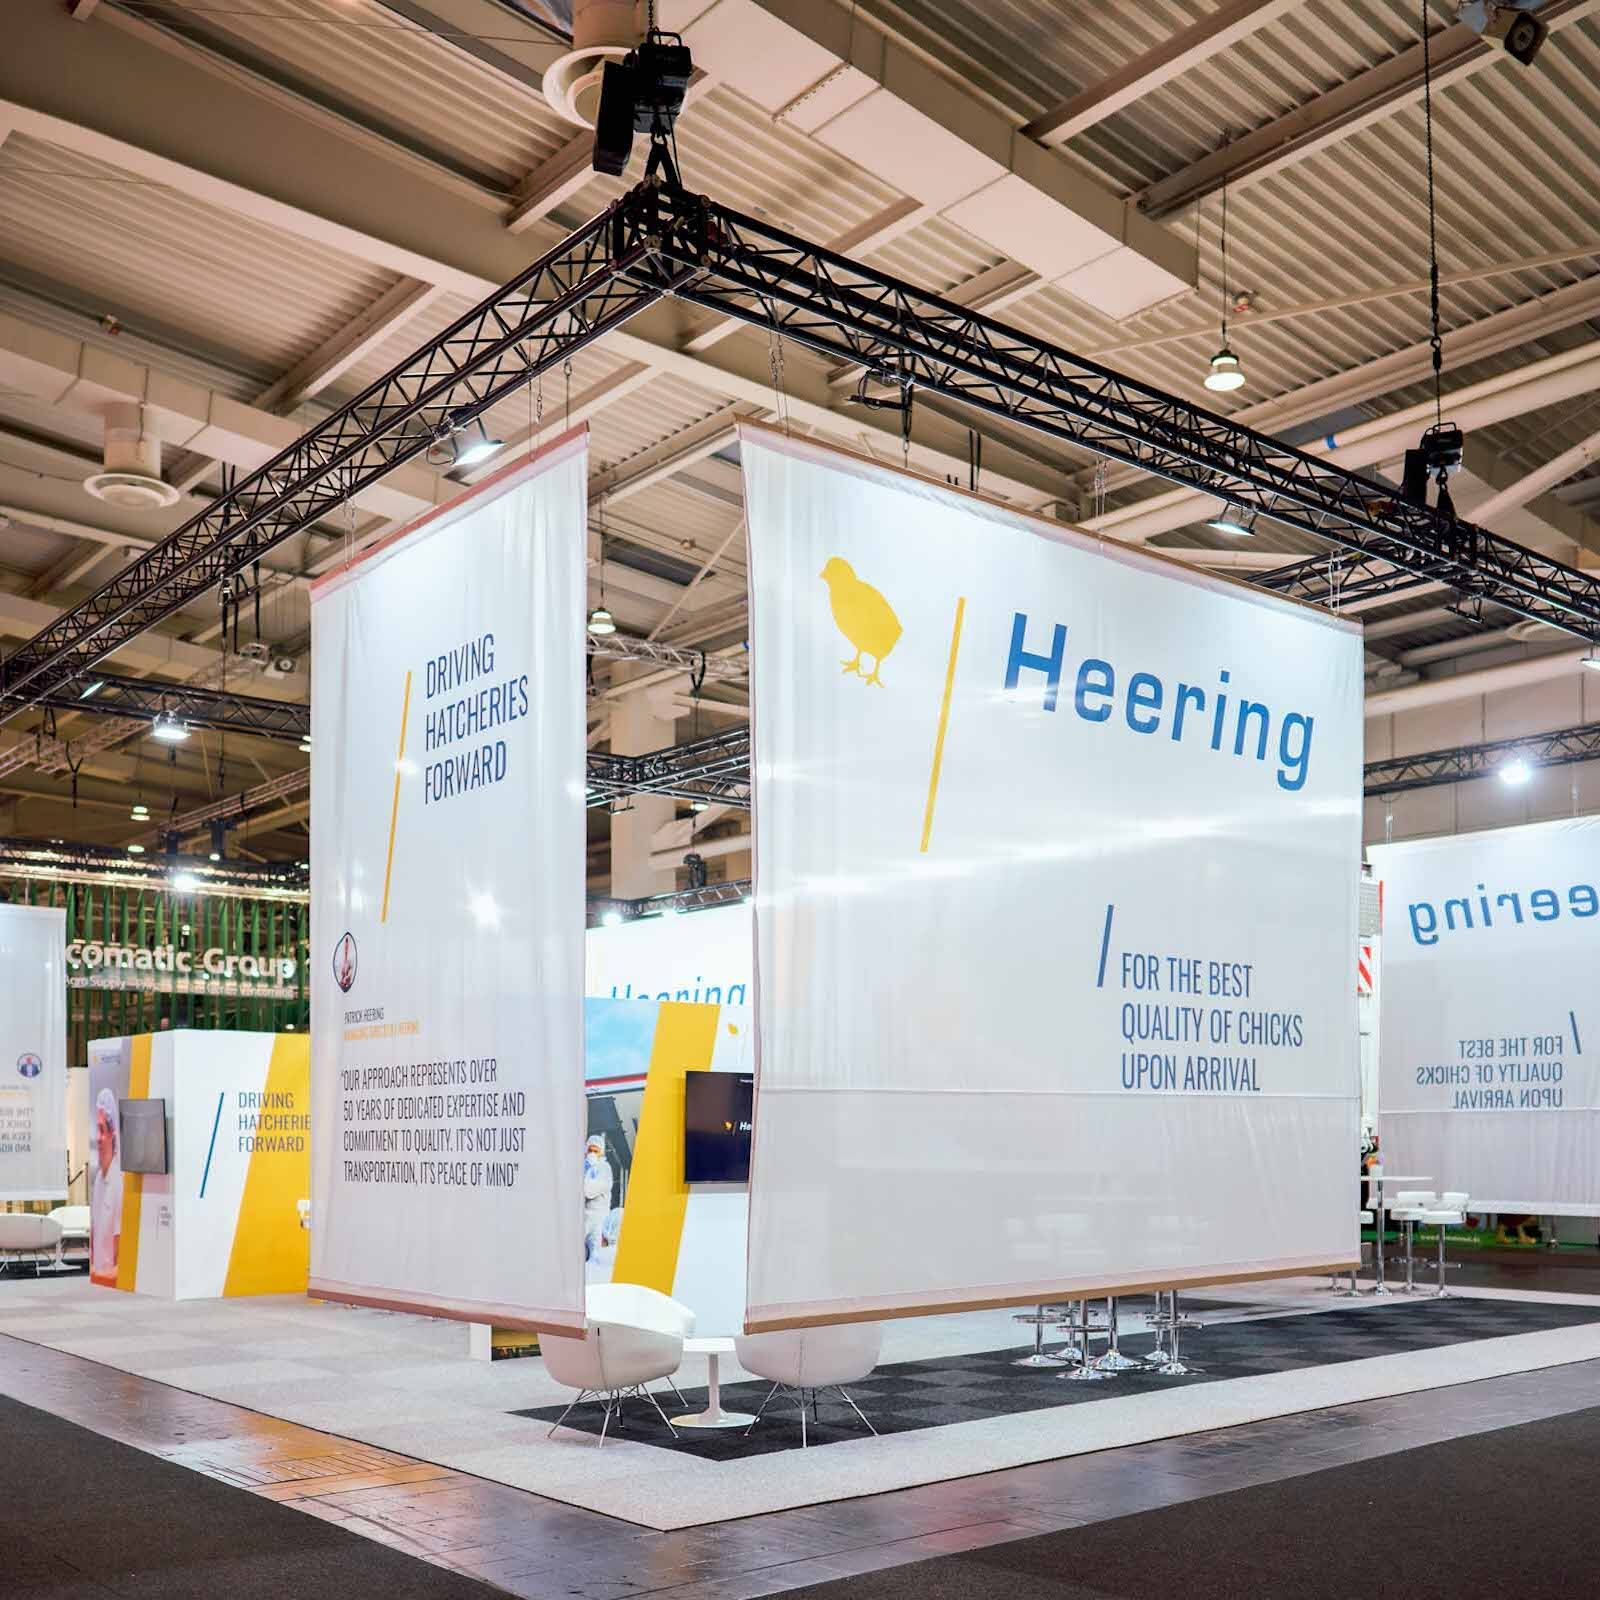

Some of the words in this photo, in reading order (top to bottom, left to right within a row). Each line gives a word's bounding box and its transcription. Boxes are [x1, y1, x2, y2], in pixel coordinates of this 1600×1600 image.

[426, 633, 494, 699] DRIVING
[426, 674, 528, 752] HATCHERIES
[1004, 612, 1314, 791] Heering
[425, 740, 507, 804] FORWARD
[66, 944, 192, 973] comatic
[203, 948, 297, 986] Group
[1122, 953, 1159, 990] FOR
[1167, 957, 1202, 994] THE
[1209, 961, 1252, 998] BEST
[1122, 1002, 1204, 1044] QUALITY
[1210, 1009, 1232, 1044] OF
[1239, 1011, 1303, 1047] CHICKS
[363, 1065, 408, 1090] APPROACH
[410, 1061, 466, 1087] REPRESENTS
[470, 1058, 497, 1084] OVER
[1122, 1052, 1176, 1089] UPON
[1184, 1055, 1260, 1091] ARRIVAL
[238, 1092, 294, 1108] DRIVING
[344, 1100, 353, 1120] 50
[356, 1100, 382, 1120] YEARS
[384, 1098, 395, 1120] OF
[398, 1096, 444, 1120] DEDICATED
[447, 1092, 499, 1118] EXPERTISE
[502, 1092, 525, 1116] AND
[238, 1114, 312, 1130] HATCHERIE
[344, 1130, 398, 1151] COMMITMENT
[400, 1130, 412, 1151] TO
[456, 1128, 473, 1152] IT'S
[476, 1128, 497, 1152] NOT
[500, 1128, 526, 1152] JUST
[238, 1136, 304, 1152] FORWARD
[344, 1160, 418, 1185] TRANSPORTATION,
[420, 1161, 436, 1184] IT'S
[438, 1162, 467, 1186] PEACE
[470, 1162, 483, 1186] OF
